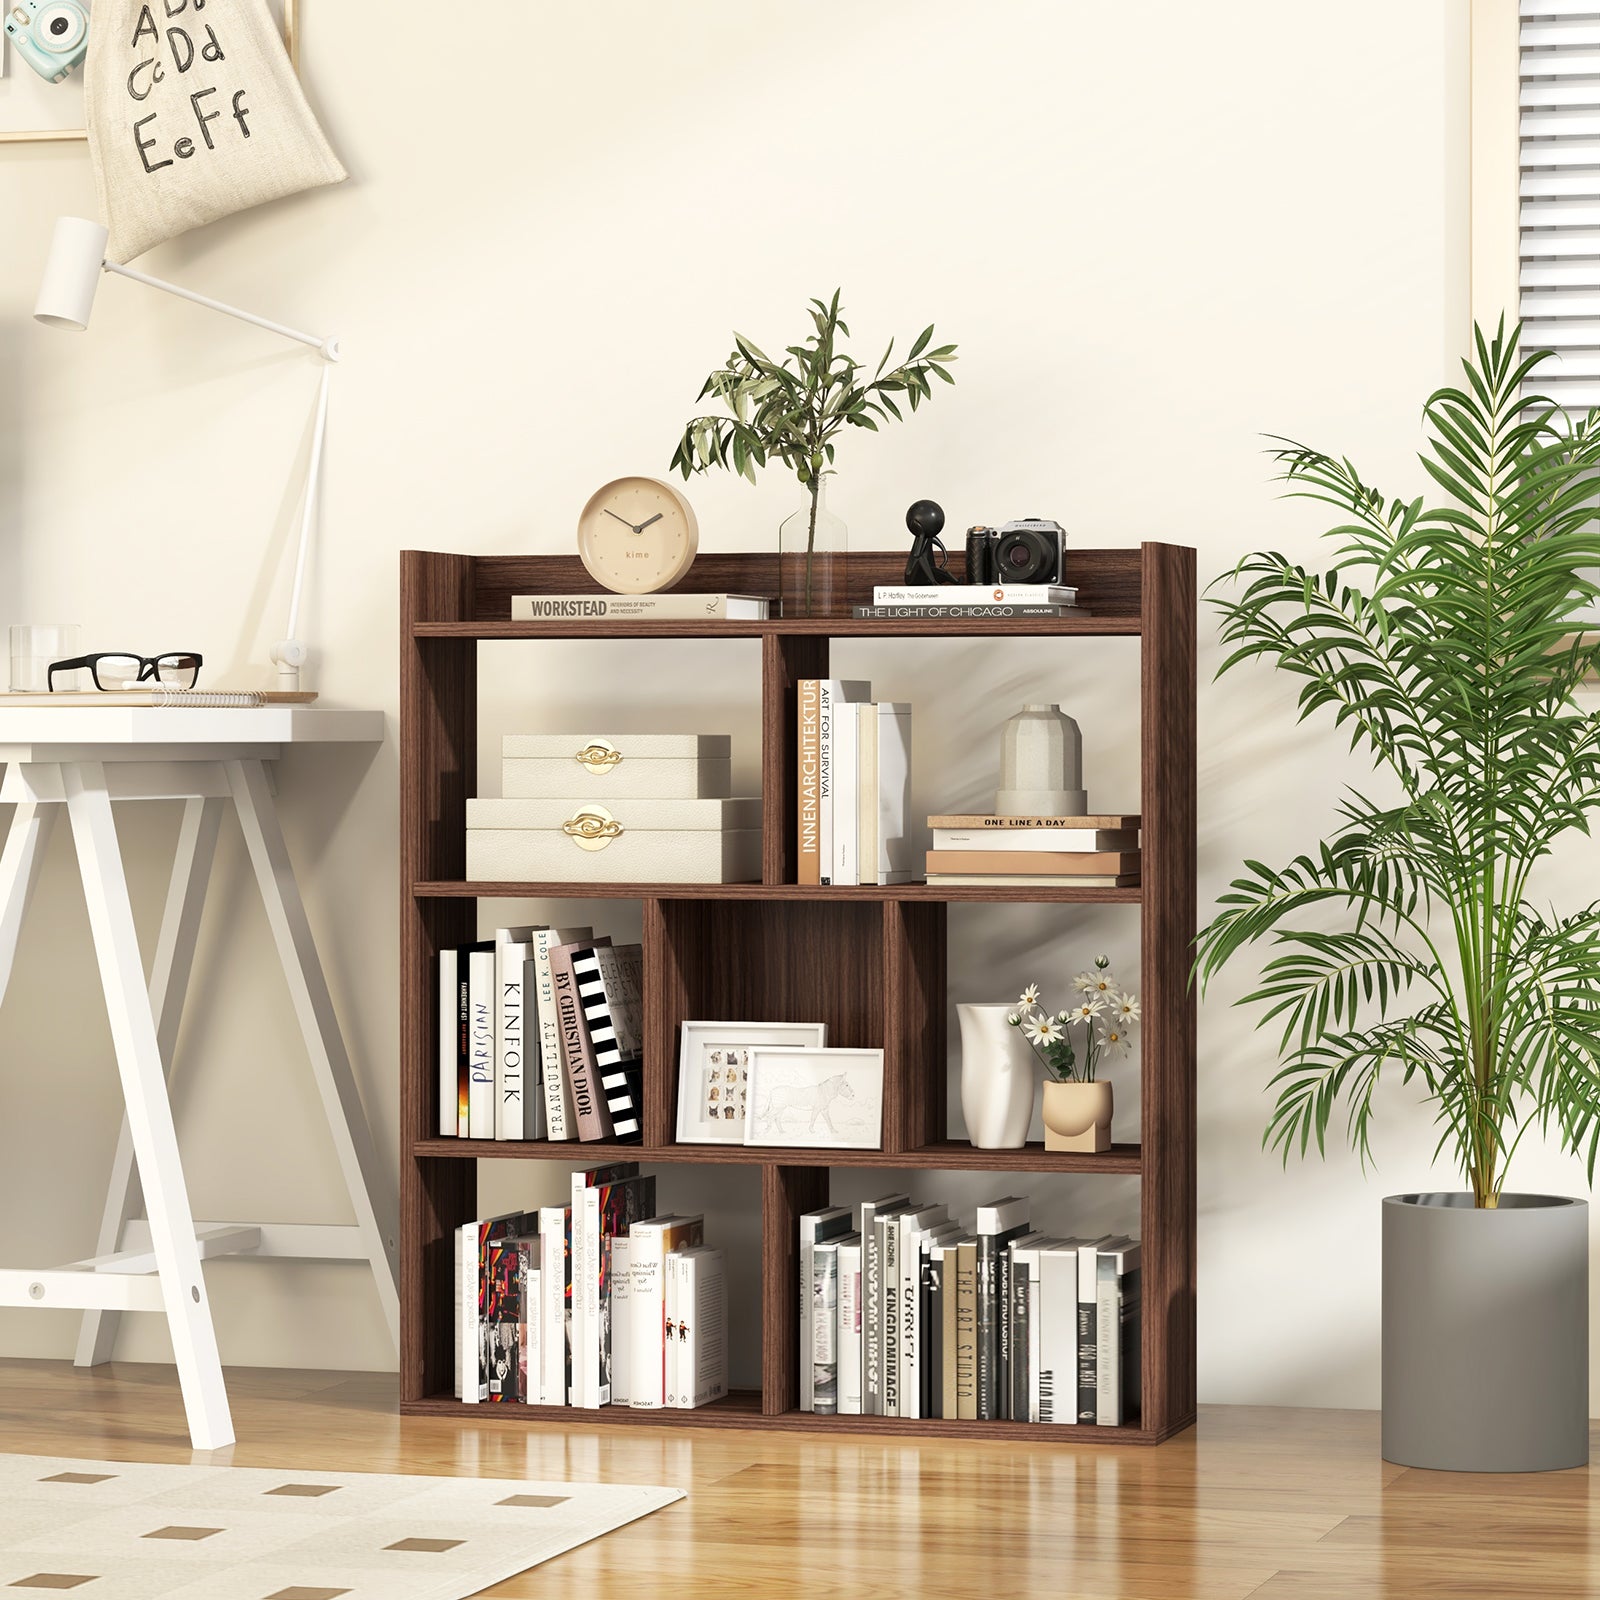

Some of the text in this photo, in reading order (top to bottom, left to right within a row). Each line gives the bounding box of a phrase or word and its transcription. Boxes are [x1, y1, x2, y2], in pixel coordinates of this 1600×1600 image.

[625, 551, 649, 559] kime
[532, 600, 607, 616] WORKSTEAD
[859, 607, 1014, 617] THE LIGHT OF CHICAGO
[821, 687, 830, 799] ART FOR SURVIVAL
[802, 680, 816, 853] INNENARCHITEKTUR
[538, 933, 548, 961] COLE
[460, 982, 468, 1011] FAHRENHEIT
[542, 982, 551, 1002] LEE
[460, 1012, 468, 1021] 451
[470, 1003, 494, 1083] PARISIAN
[504, 983, 521, 1103] KINFOLK
[555, 971, 592, 1117] BY CHRISTIAN DIOR
[544, 1021, 563, 1134] TRANQUILITY
[887, 1226, 895, 1267] SHENZHEN
[957, 1270, 972, 1398] THE ART STUDIO
